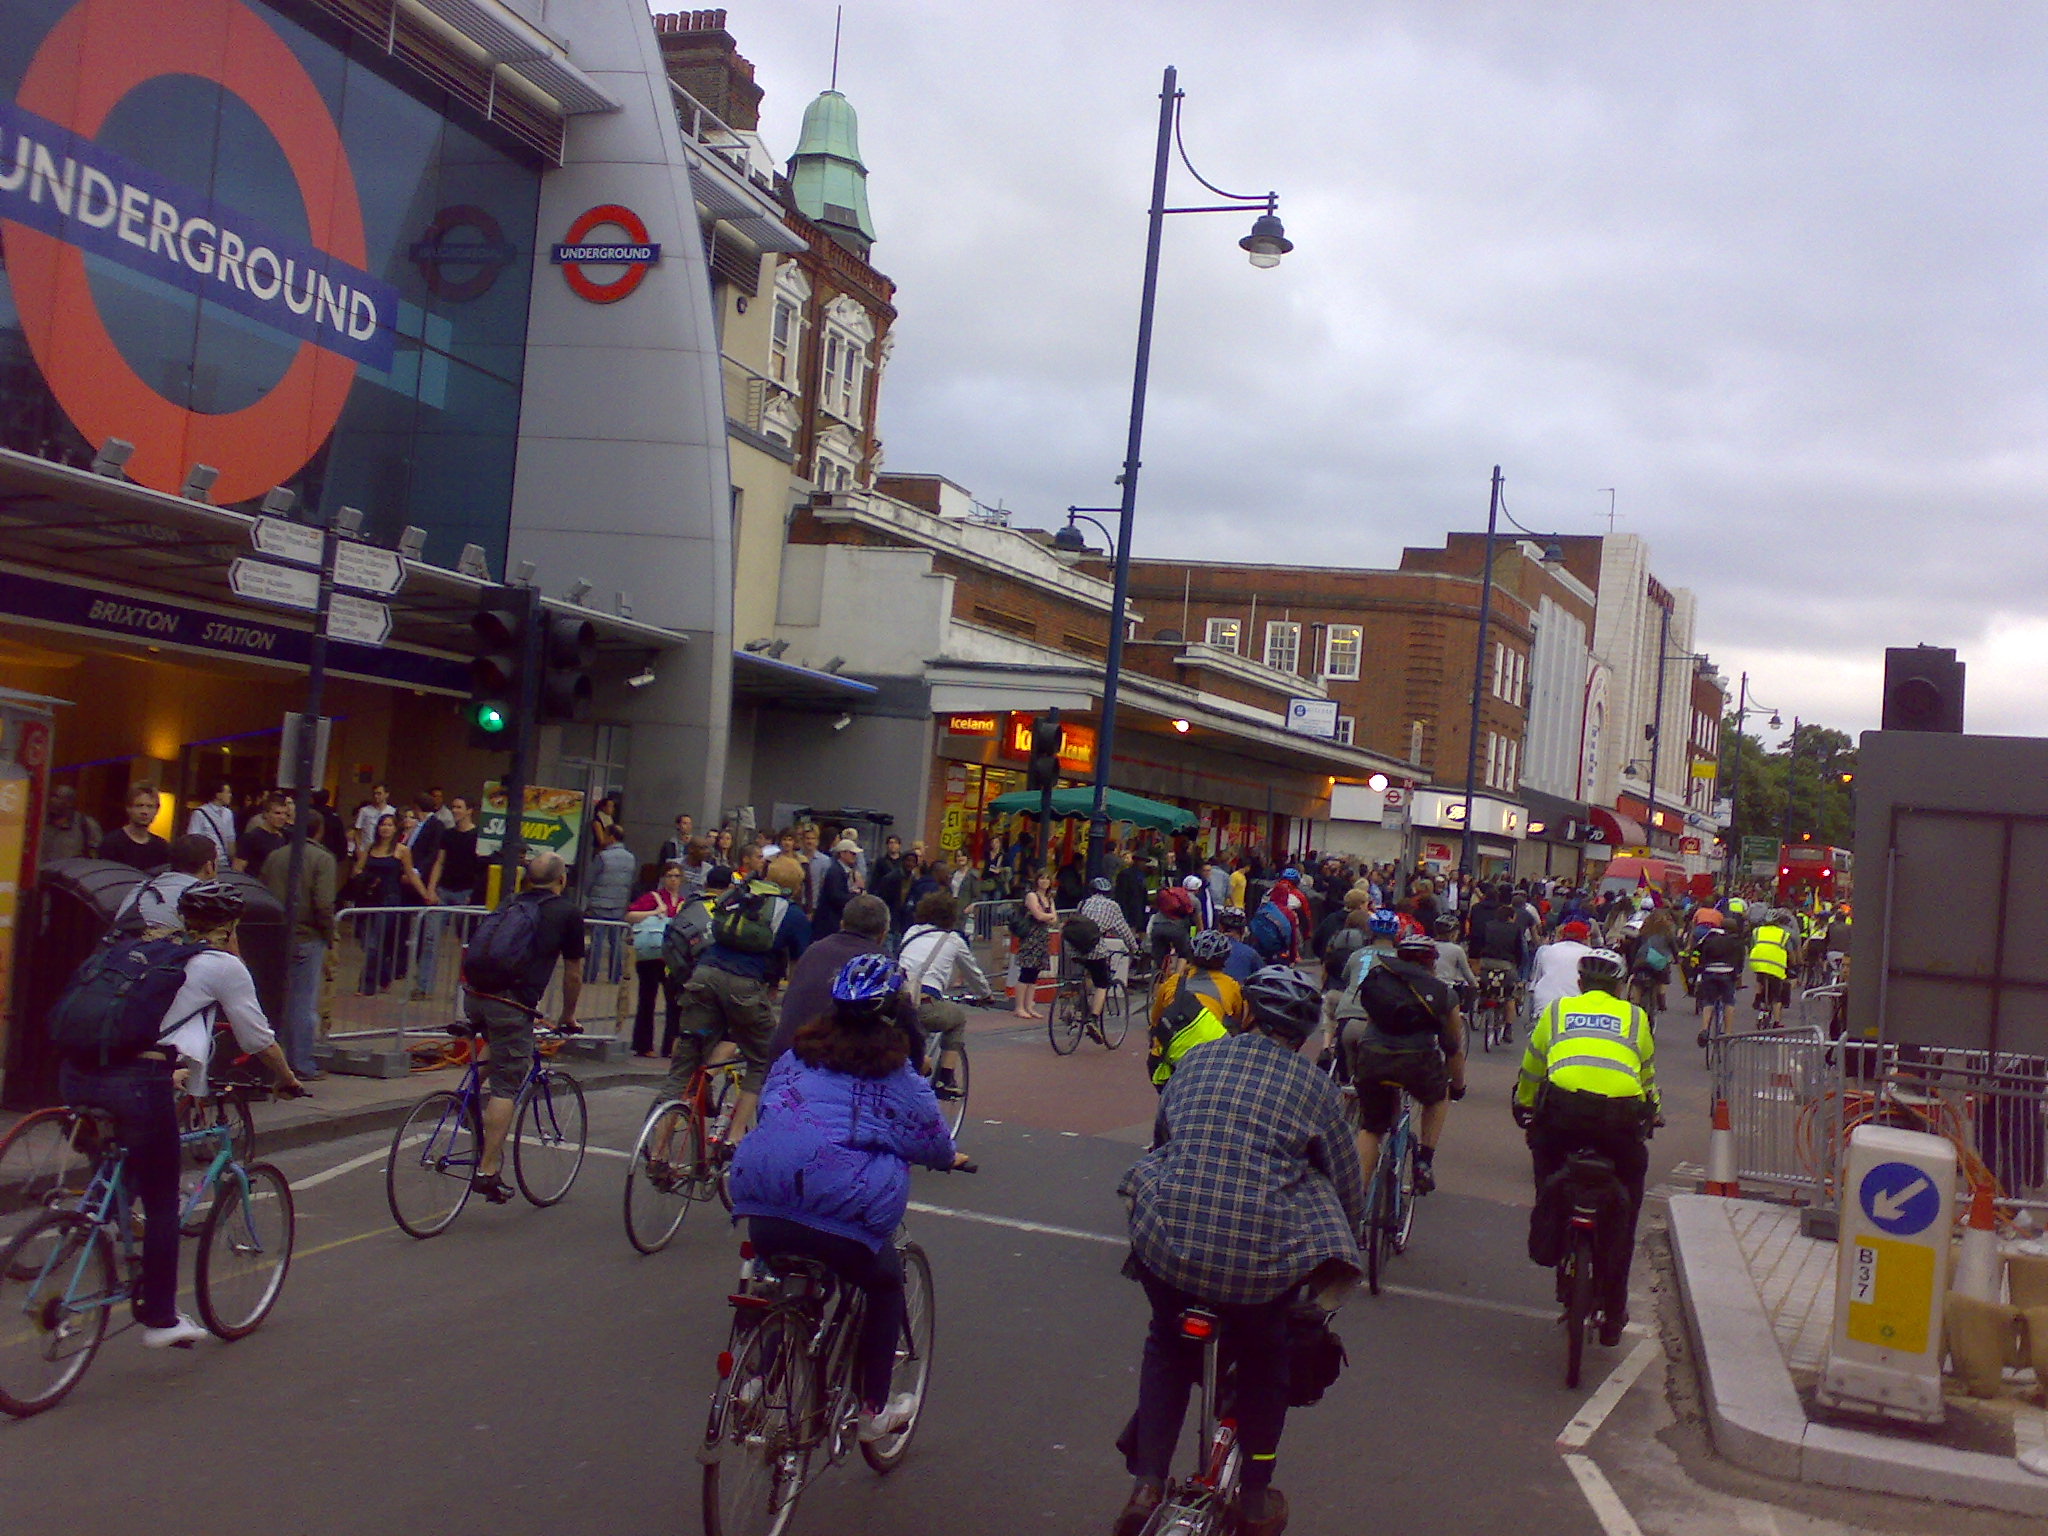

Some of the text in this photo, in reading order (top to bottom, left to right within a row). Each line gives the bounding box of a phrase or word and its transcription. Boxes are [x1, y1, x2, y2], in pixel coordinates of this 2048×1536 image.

[0, 126, 378, 342] UNDERGROUND
[560, 247, 651, 259] UNDERGROUND
[88, 600, 277, 650] BRIXTON STATION
[950, 717, 994, 731] Iceland
[483, 818, 561, 841] SUWAY
[1565, 1015, 1621, 1031] POLICE
[1858, 1247, 1873, 1298] B37
